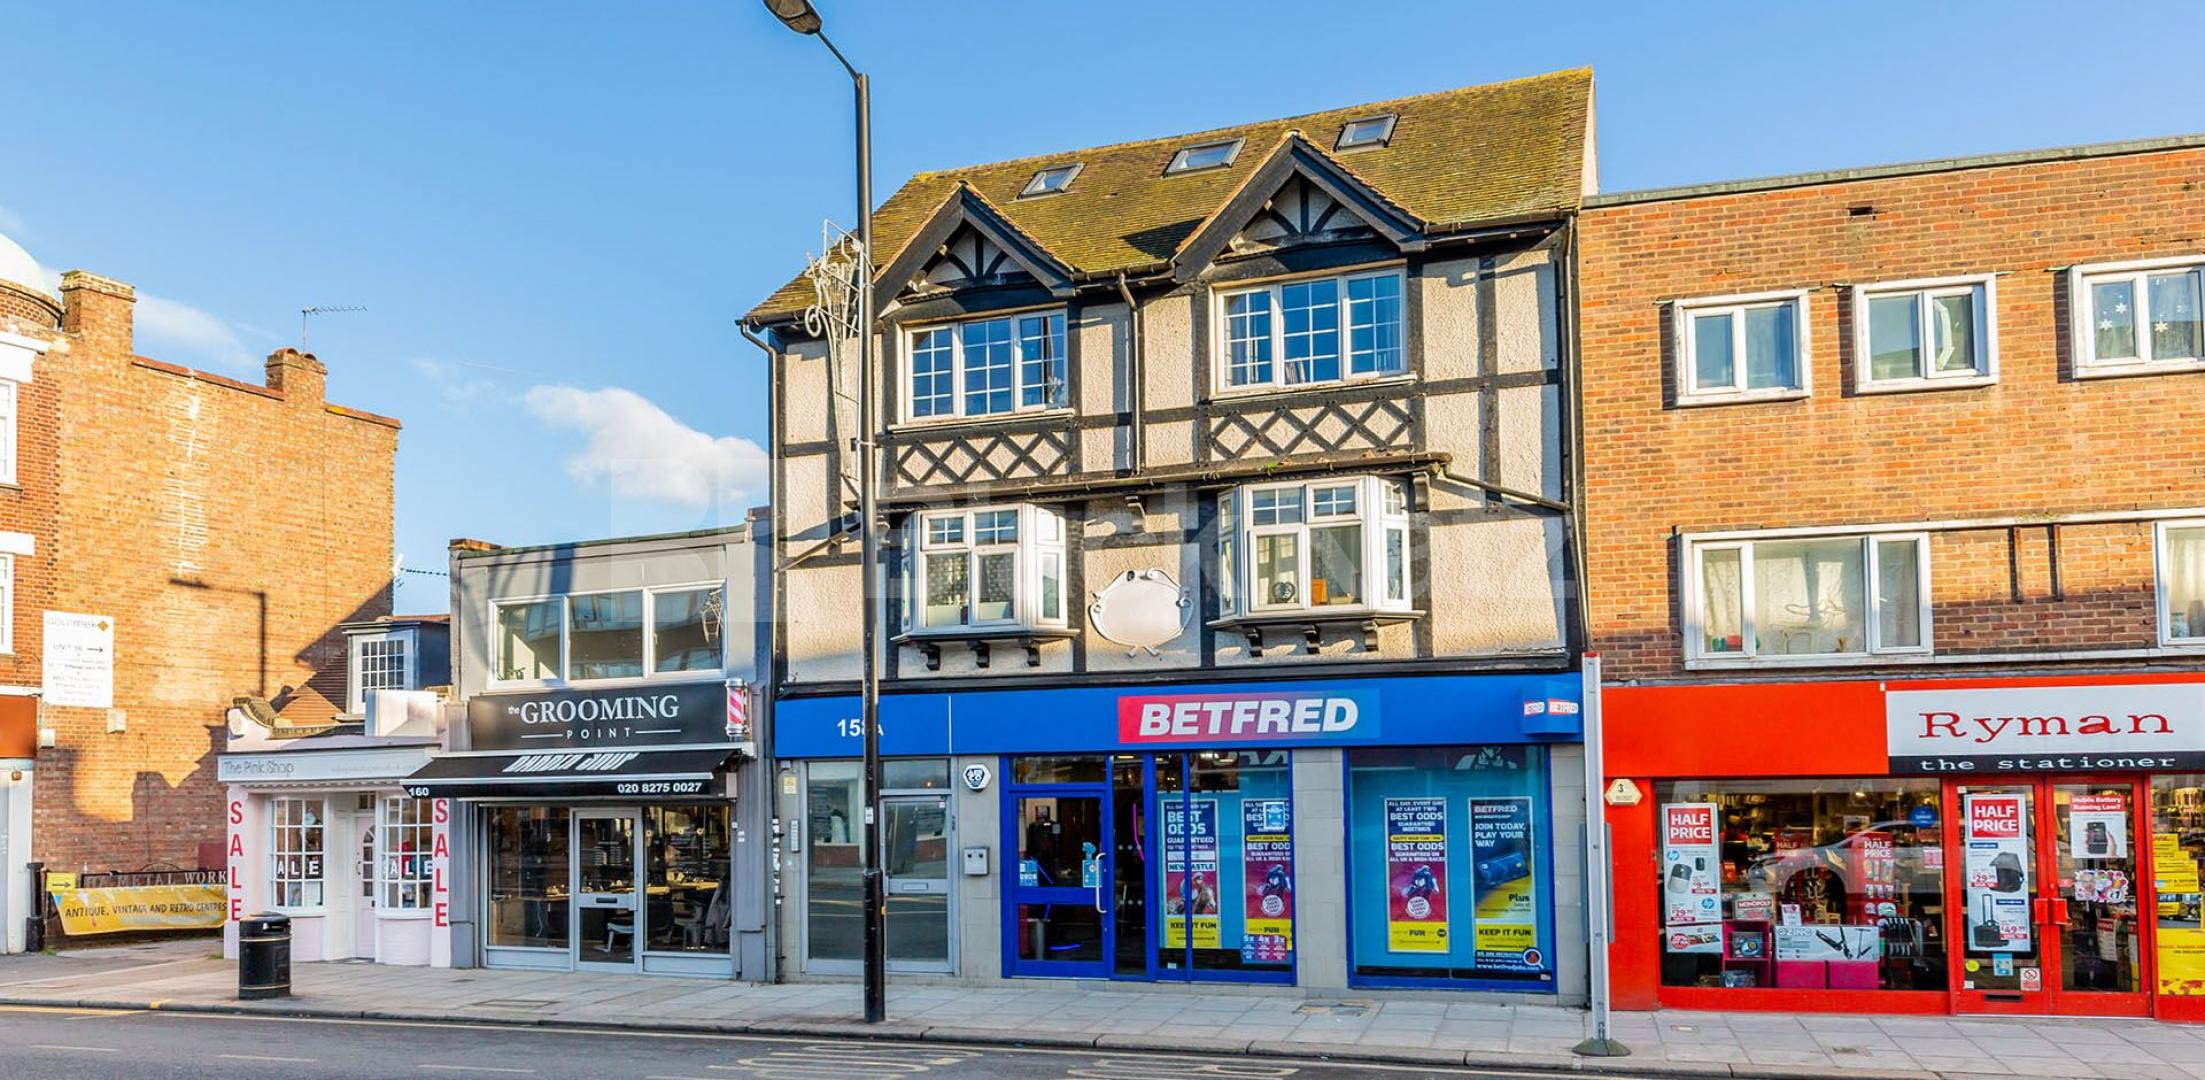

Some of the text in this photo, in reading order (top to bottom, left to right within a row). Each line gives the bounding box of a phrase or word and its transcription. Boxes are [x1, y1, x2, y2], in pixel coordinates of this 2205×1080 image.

[508, 695, 679, 724] the GROOMING
[1139, 697, 1359, 736] BETFRED
[566, 727, 631, 740] POINT
[1918, 712, 2175, 743] Ryman
[224, 760, 294, 776] The Pink Shop
[1921, 756, 2177, 771] the stationer
[408, 787, 429, 797] 160
[618, 782, 702, 794] 020 8275 0027
[1474, 805, 1518, 813] BETFRED
[1974, 805, 2016, 817] HALF
[1390, 812, 1443, 820] BEST ODDS
[1671, 813, 1708, 825] HALF
[1495, 823, 1526, 831] TODAY,
[1973, 819, 2017, 832] PRICE
[1671, 827, 1711, 839] PRICE
[1247, 842, 1270, 850] BEST
[1864, 841, 1891, 849] HALF
[1864, 849, 1892, 857] PRICE
[230, 801, 244, 921] SALE
[434, 799, 449, 927] SALE
[277, 860, 319, 876] ALE
[1508, 893, 1530, 902] Plus
[150, 903, 166, 912] AND
[170, 902, 195, 912] RETRO
